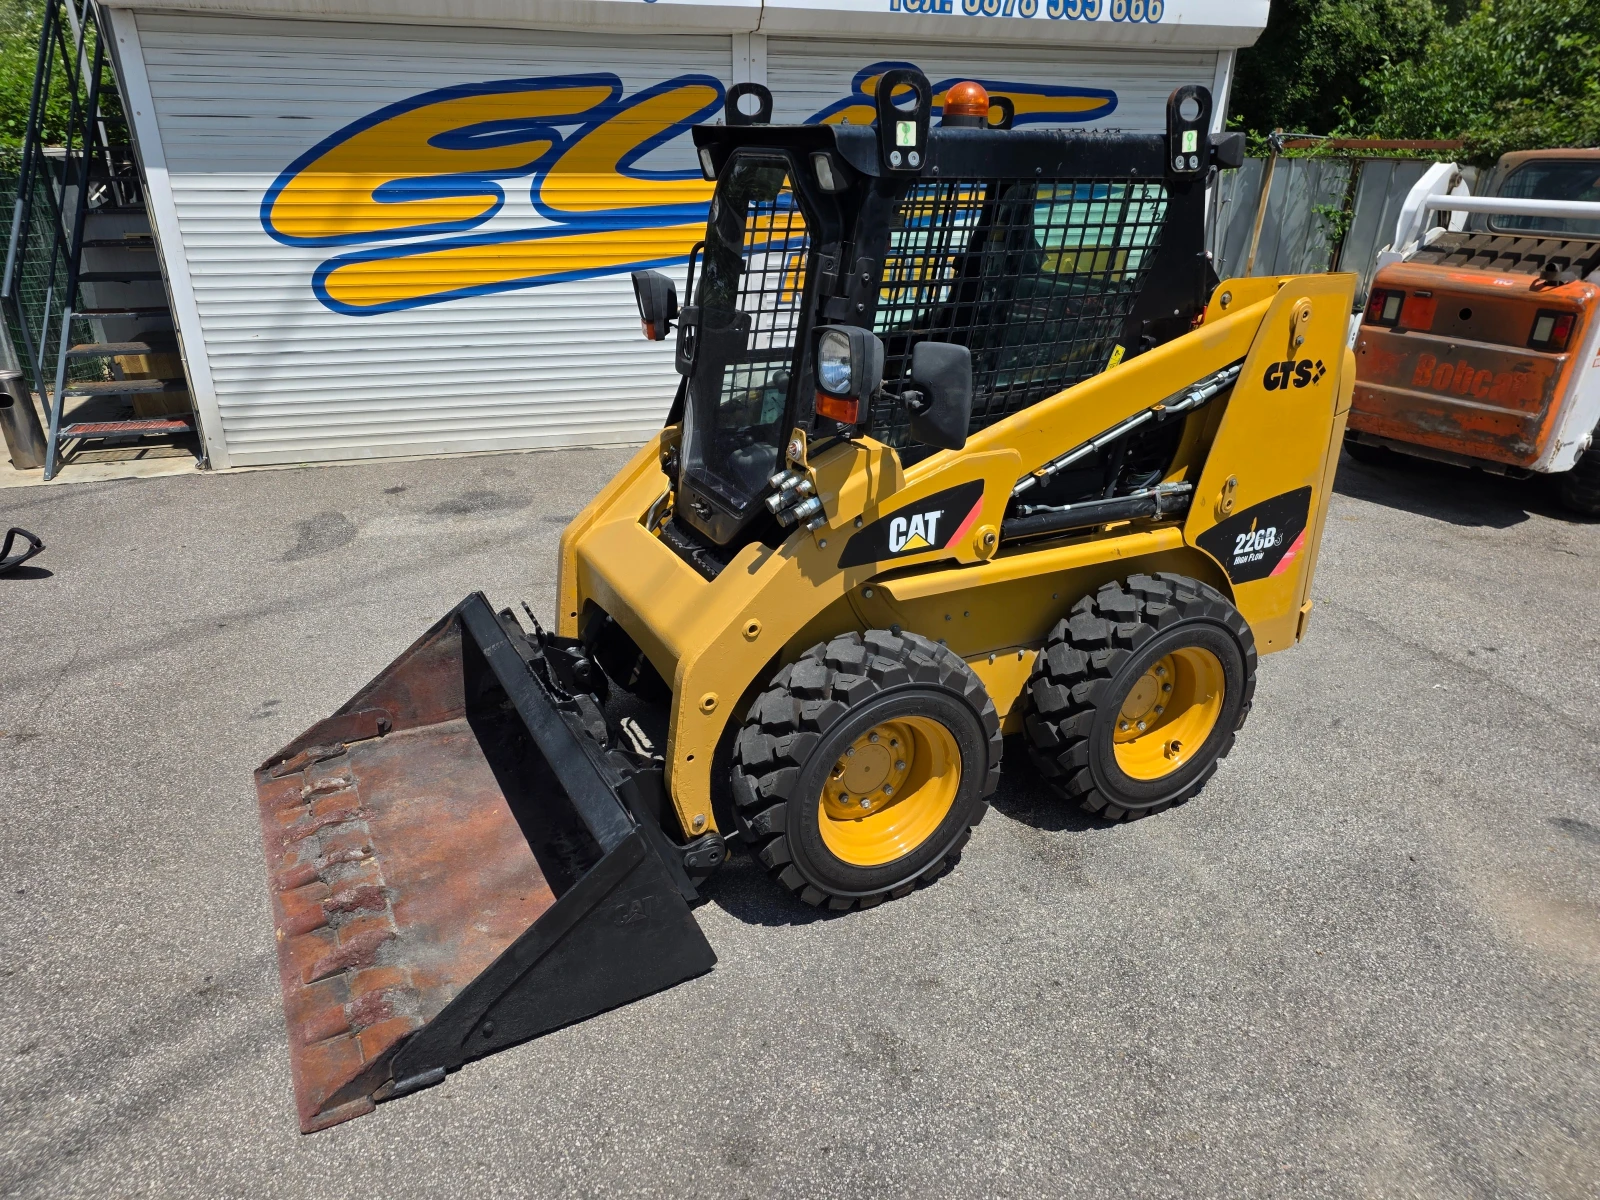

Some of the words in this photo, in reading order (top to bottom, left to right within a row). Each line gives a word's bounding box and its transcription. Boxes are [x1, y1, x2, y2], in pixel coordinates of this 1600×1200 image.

[1110, 0, 1164, 23] 666
[1263, 359, 1313, 391] GTS
[1411, 352, 1530, 405] Bobca
[889, 510, 942, 553] CAT
